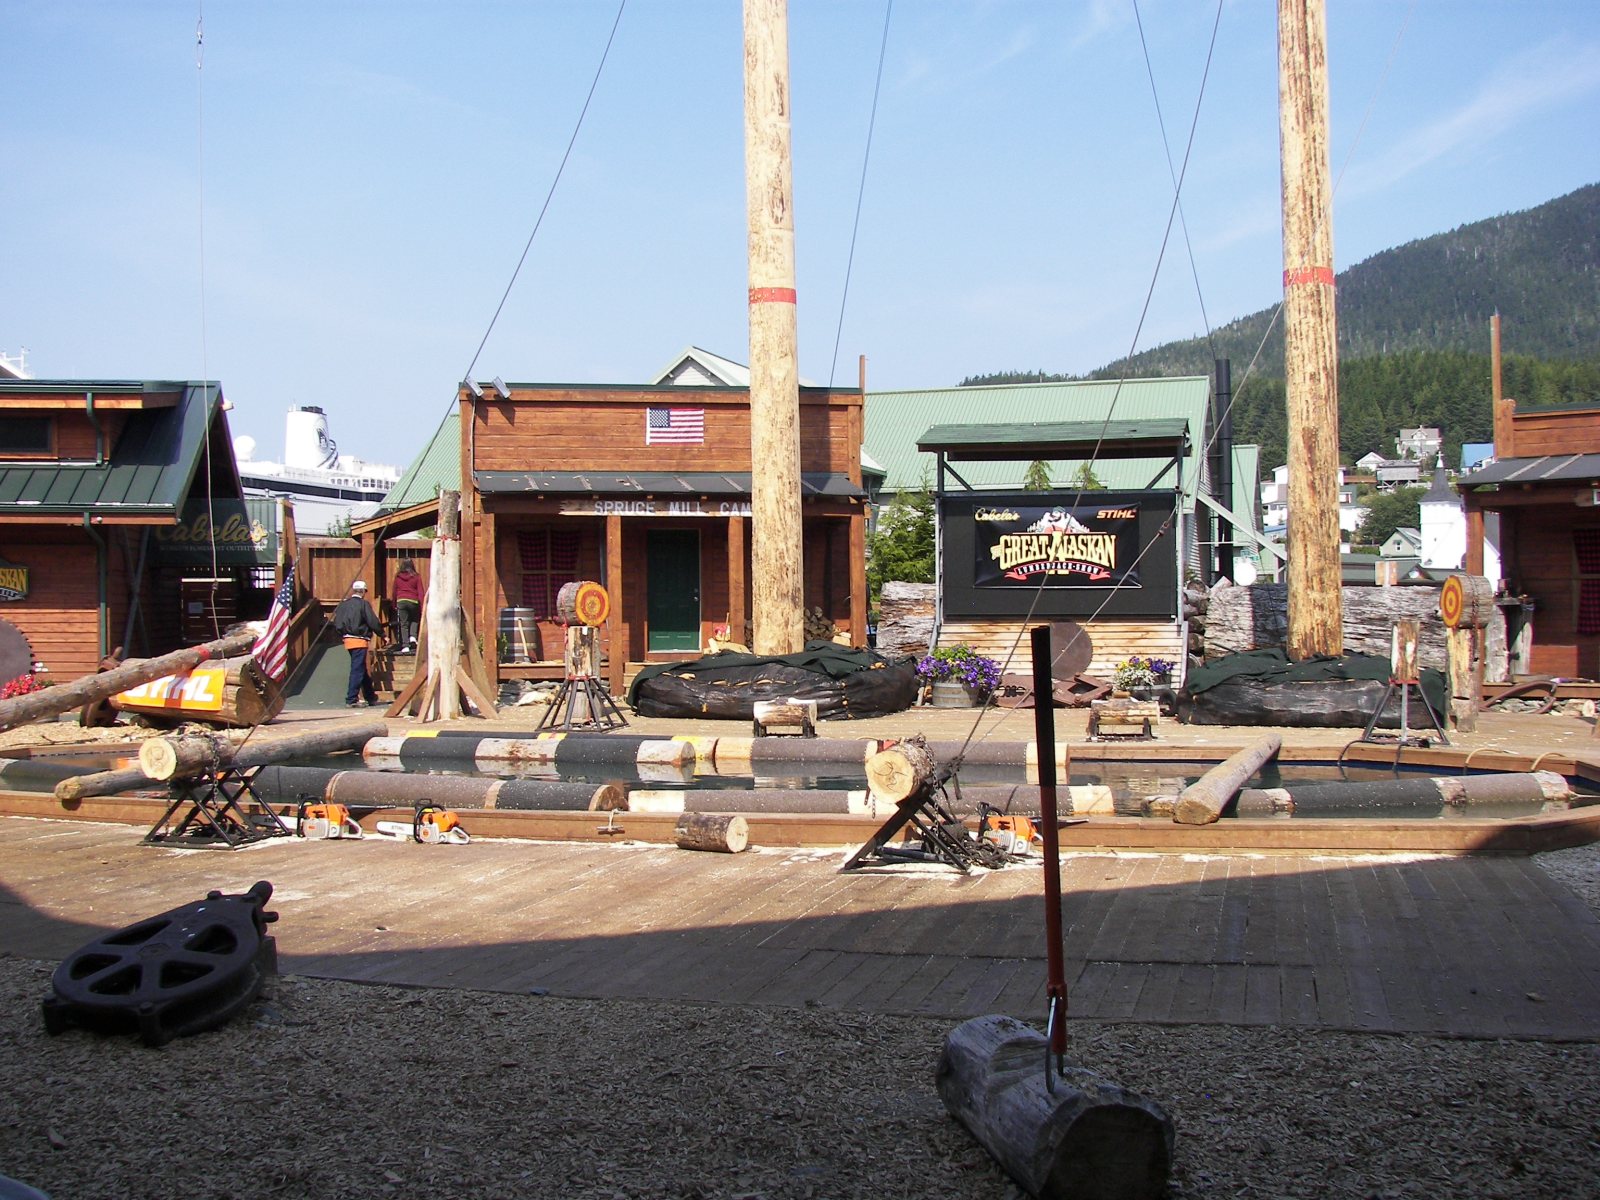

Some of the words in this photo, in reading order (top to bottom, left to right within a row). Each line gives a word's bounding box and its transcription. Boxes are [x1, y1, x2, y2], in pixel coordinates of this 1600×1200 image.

[594, 501, 656, 516] SPRUCE
[668, 501, 709, 516] MILL
[719, 501, 753, 516] CAM
[974, 507, 1020, 521] Cabela's
[1096, 509, 1136, 519] STIHL
[999, 535, 1050, 570] GREAT
[1047, 531, 1116, 575] ALASKAN
